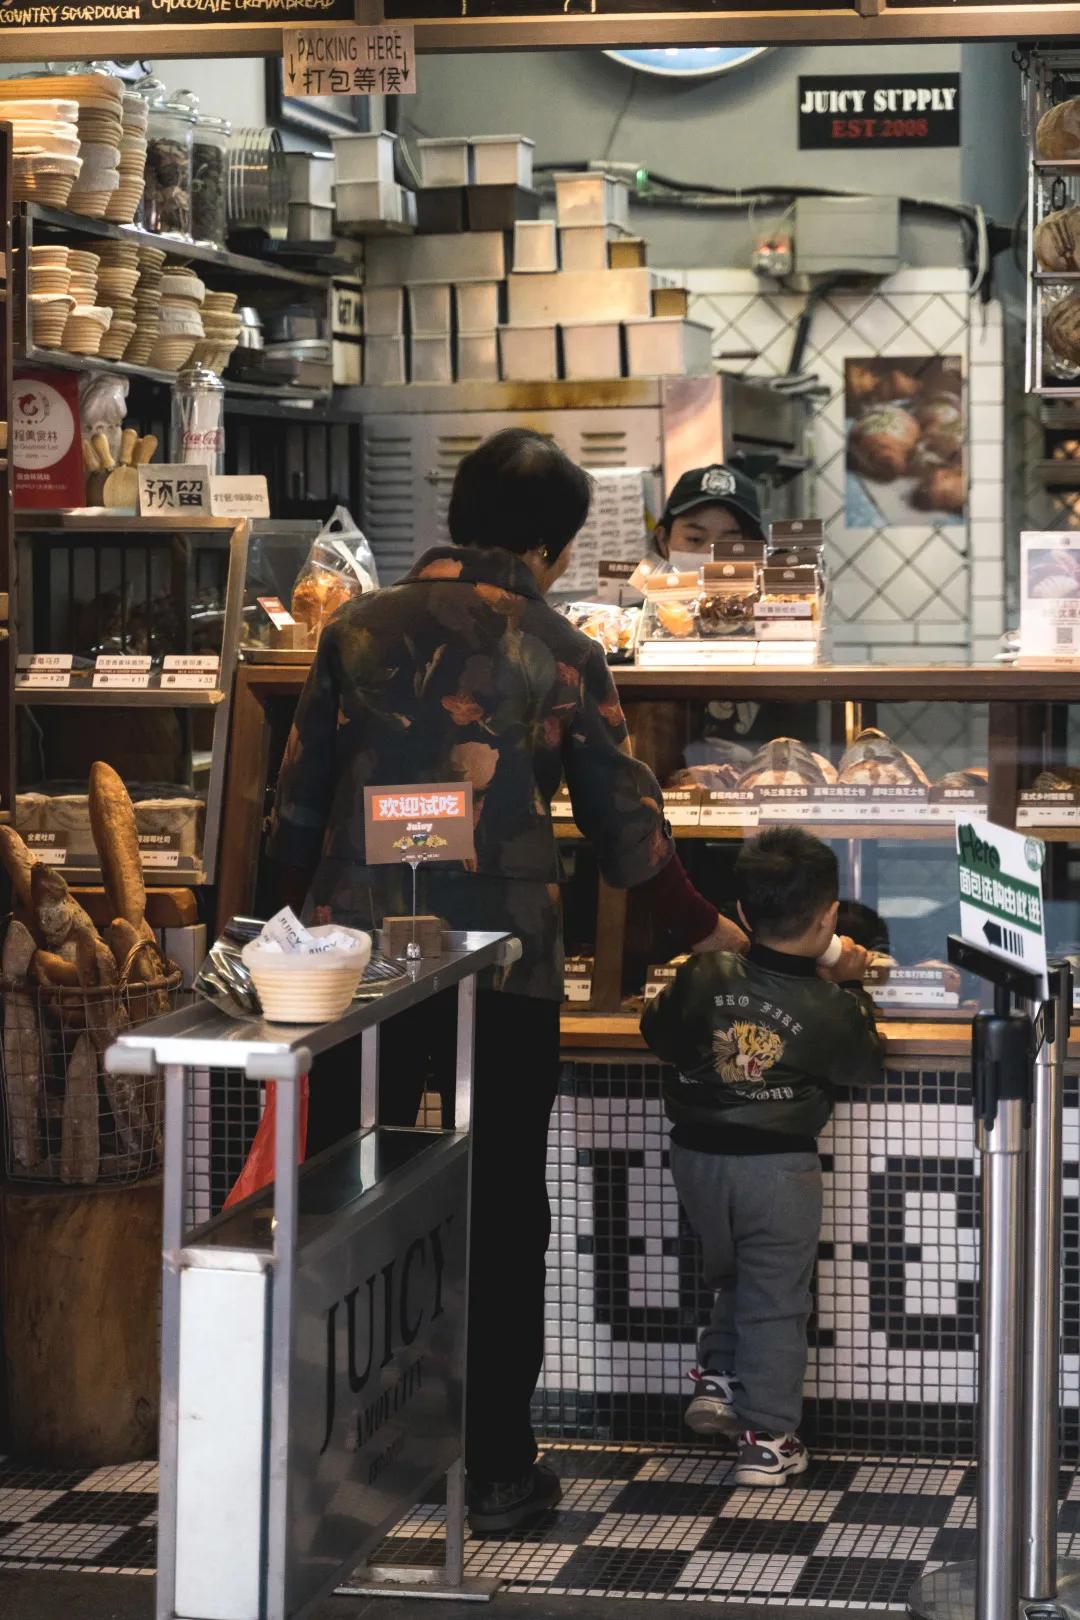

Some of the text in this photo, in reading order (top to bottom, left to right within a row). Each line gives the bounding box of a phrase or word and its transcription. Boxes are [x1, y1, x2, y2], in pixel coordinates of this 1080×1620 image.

[0, 6, 140, 25] COUNTRY SOURDOUGH
[297, 36, 402, 61] PACKING HERE
[801, 88, 957, 113] JUICY SUPPLY
[832, 119, 875, 138] EST
[144, 479, 204, 508] 预留
[379, 795, 460, 818] 欢迎试吃
[958, 823, 1000, 869] Here
[959, 866, 1041, 925] 面包选购由此进
[319, 1213, 455, 1456] JUICY
